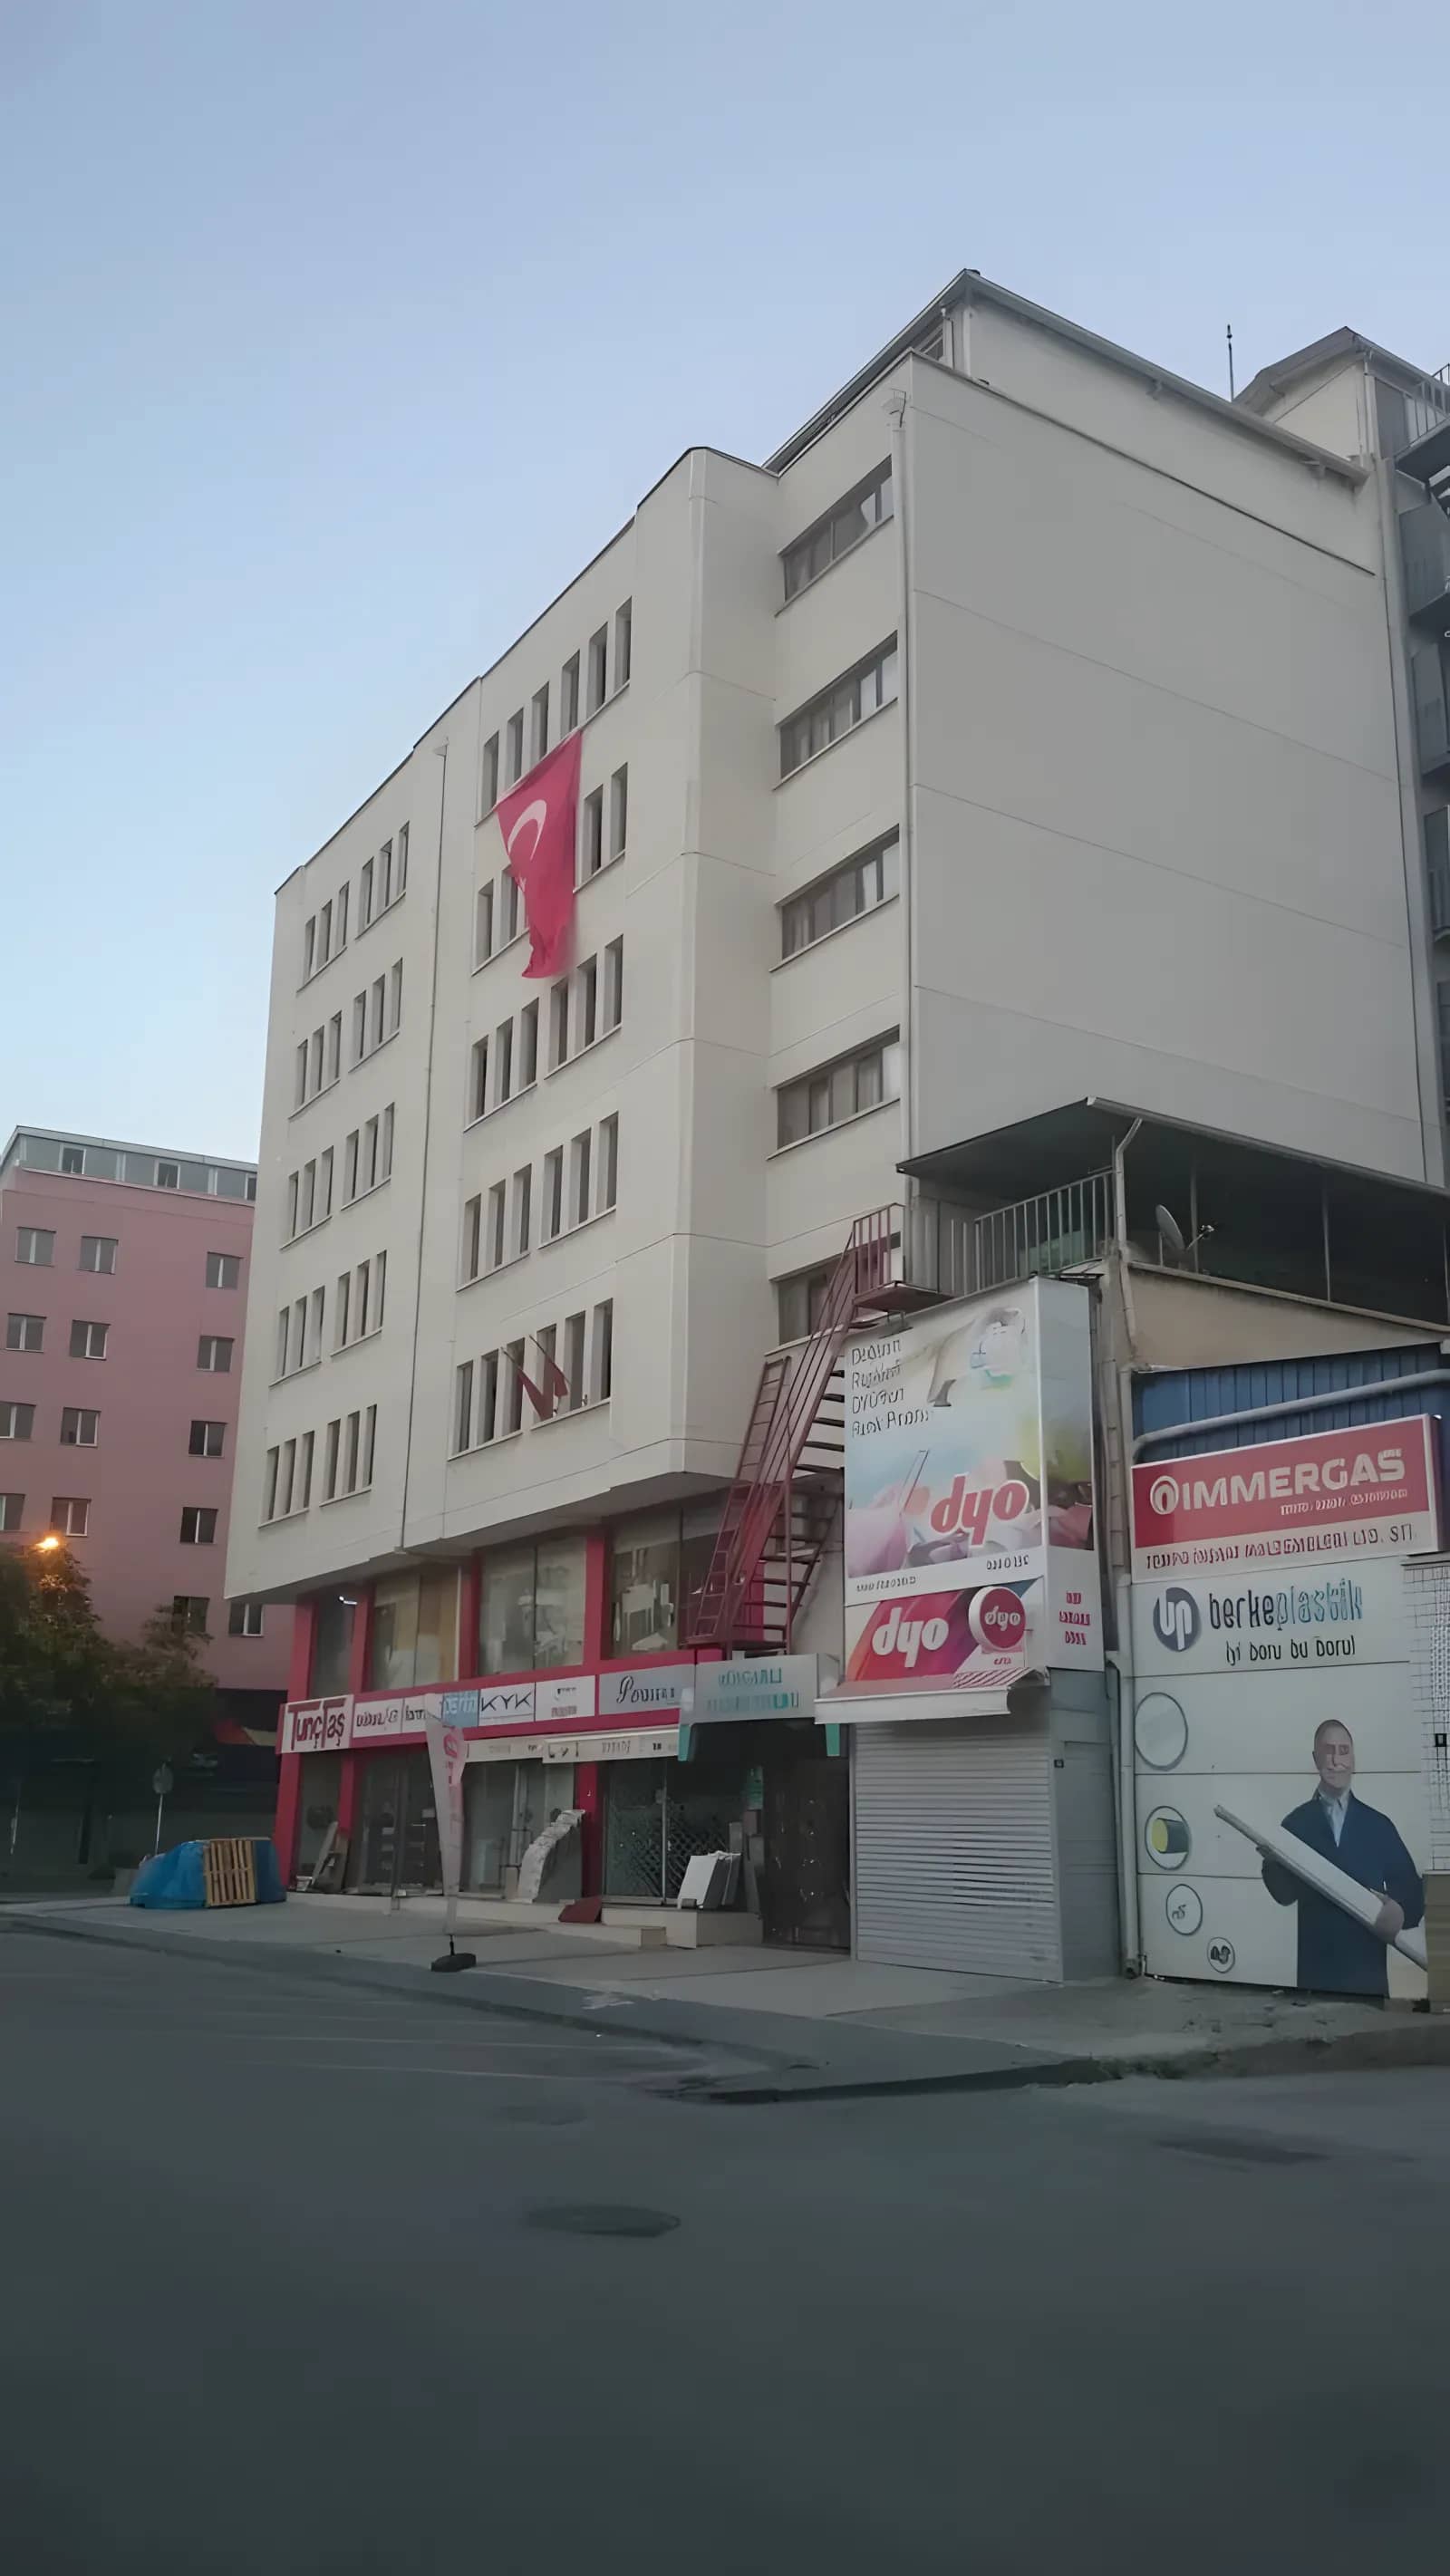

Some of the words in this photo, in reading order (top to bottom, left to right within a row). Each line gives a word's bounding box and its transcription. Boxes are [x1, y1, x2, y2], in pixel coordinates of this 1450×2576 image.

[1182, 1448, 1406, 1510] IMMERGAS
[930, 1473, 1030, 1548] dyo
[871, 1606, 950, 1668] dyo
[984, 1606, 1022, 1632] dyo
[481, 1691, 533, 1712] KYK
